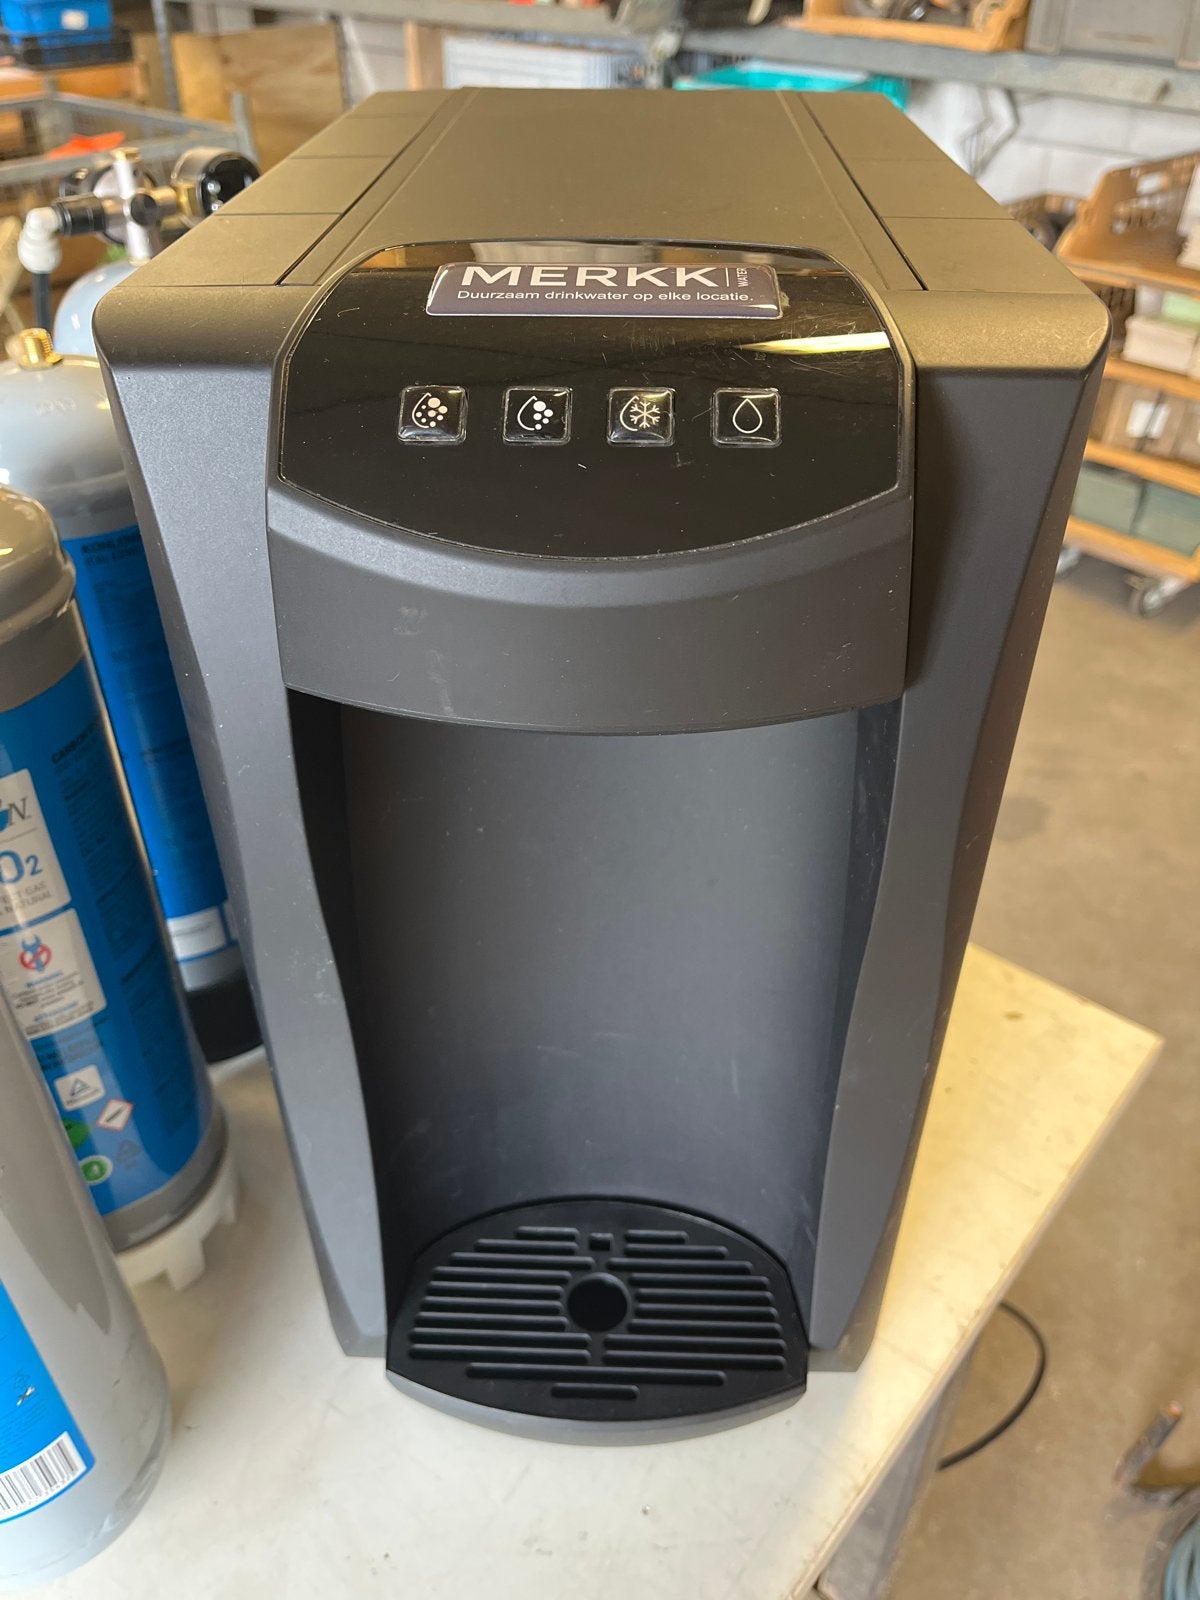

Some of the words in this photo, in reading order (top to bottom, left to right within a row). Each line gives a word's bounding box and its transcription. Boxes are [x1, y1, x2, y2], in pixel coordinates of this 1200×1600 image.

[461, 266, 719, 288] MERKK
[736, 267, 749, 288] WATER
[457, 290, 540, 300] Duurzaam
[544, 291, 629, 300] drinkwater
[632, 292, 653, 302] op
[658, 291, 692, 301] elke
[696, 292, 754, 301] locatie.
